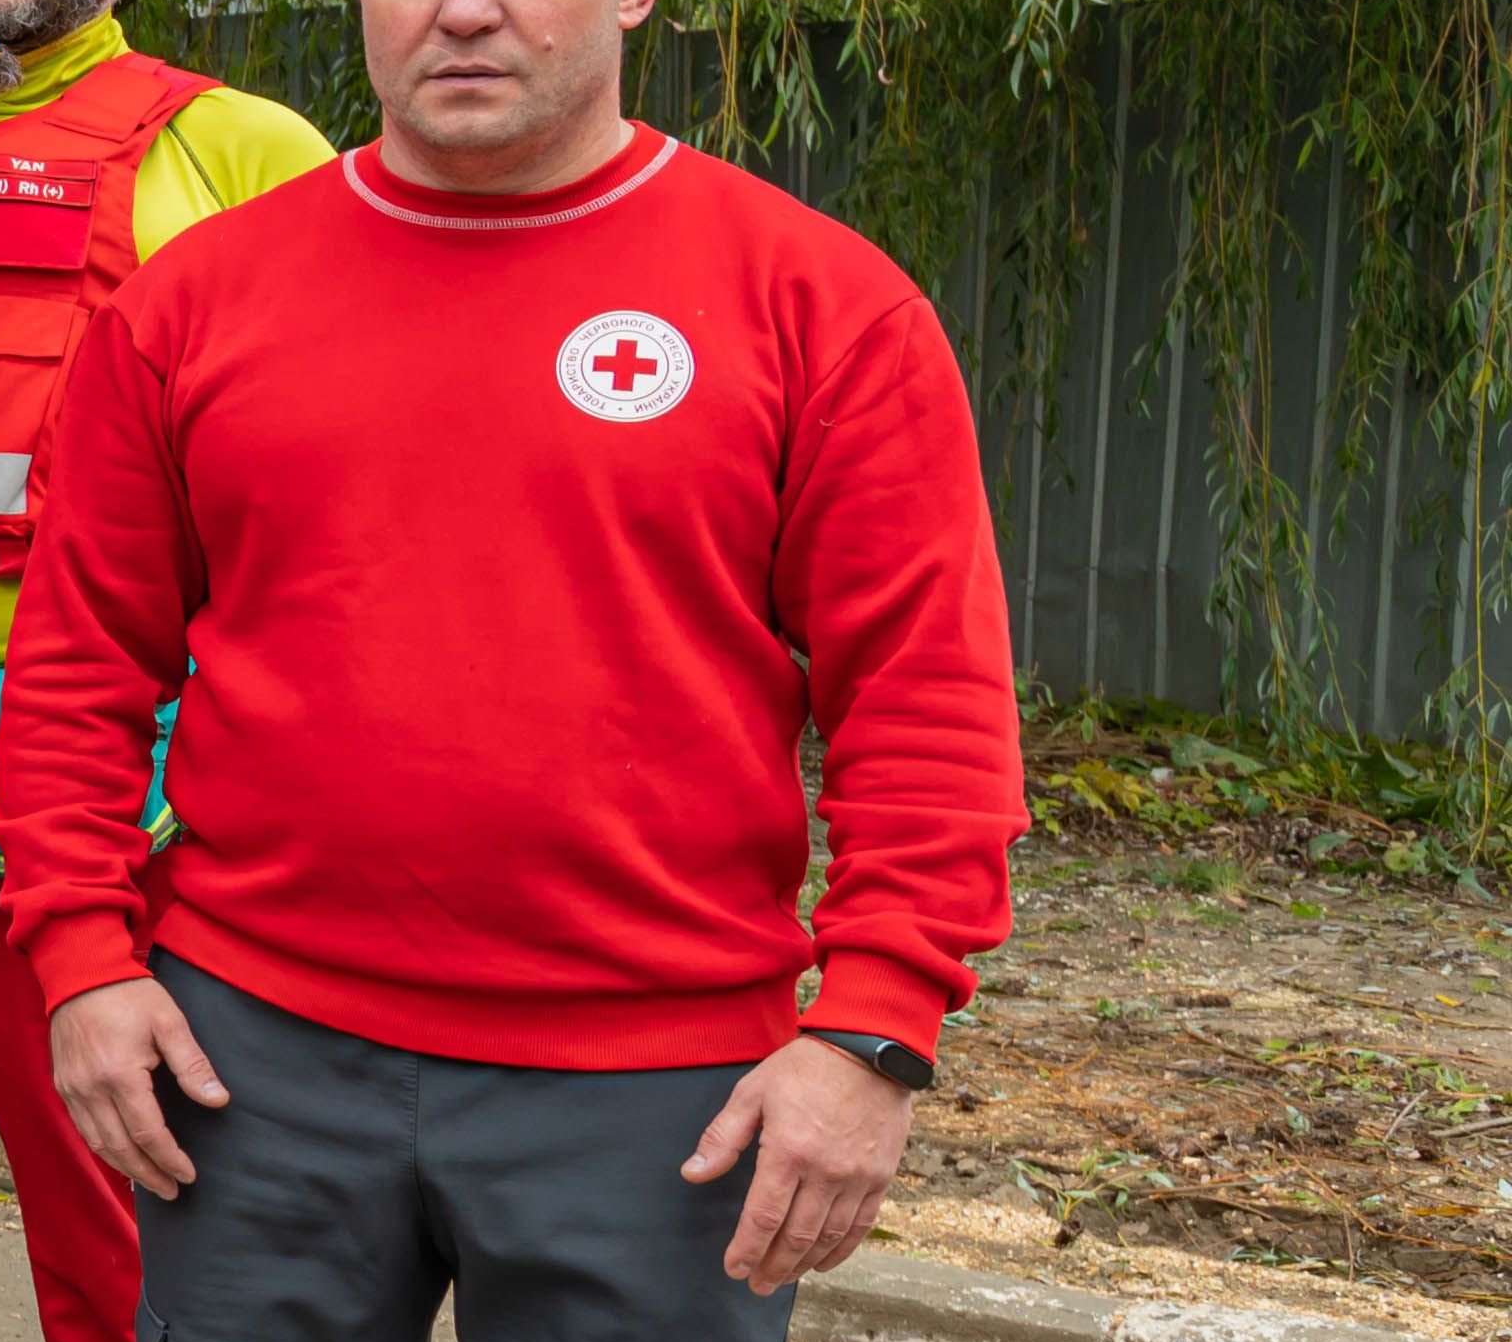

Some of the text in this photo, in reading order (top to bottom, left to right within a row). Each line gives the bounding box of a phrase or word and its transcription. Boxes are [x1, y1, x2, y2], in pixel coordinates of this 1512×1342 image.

[10, 157, 45, 172] YAN
[18, 181, 38, 195] Rh
[43, 184, 64, 199] (+)
[579, 318, 655, 343] ЧЕРВОНОГО
[660, 332, 684, 372] ХРЕСТА
[566, 347, 606, 410] ТОВАРИСТВО
